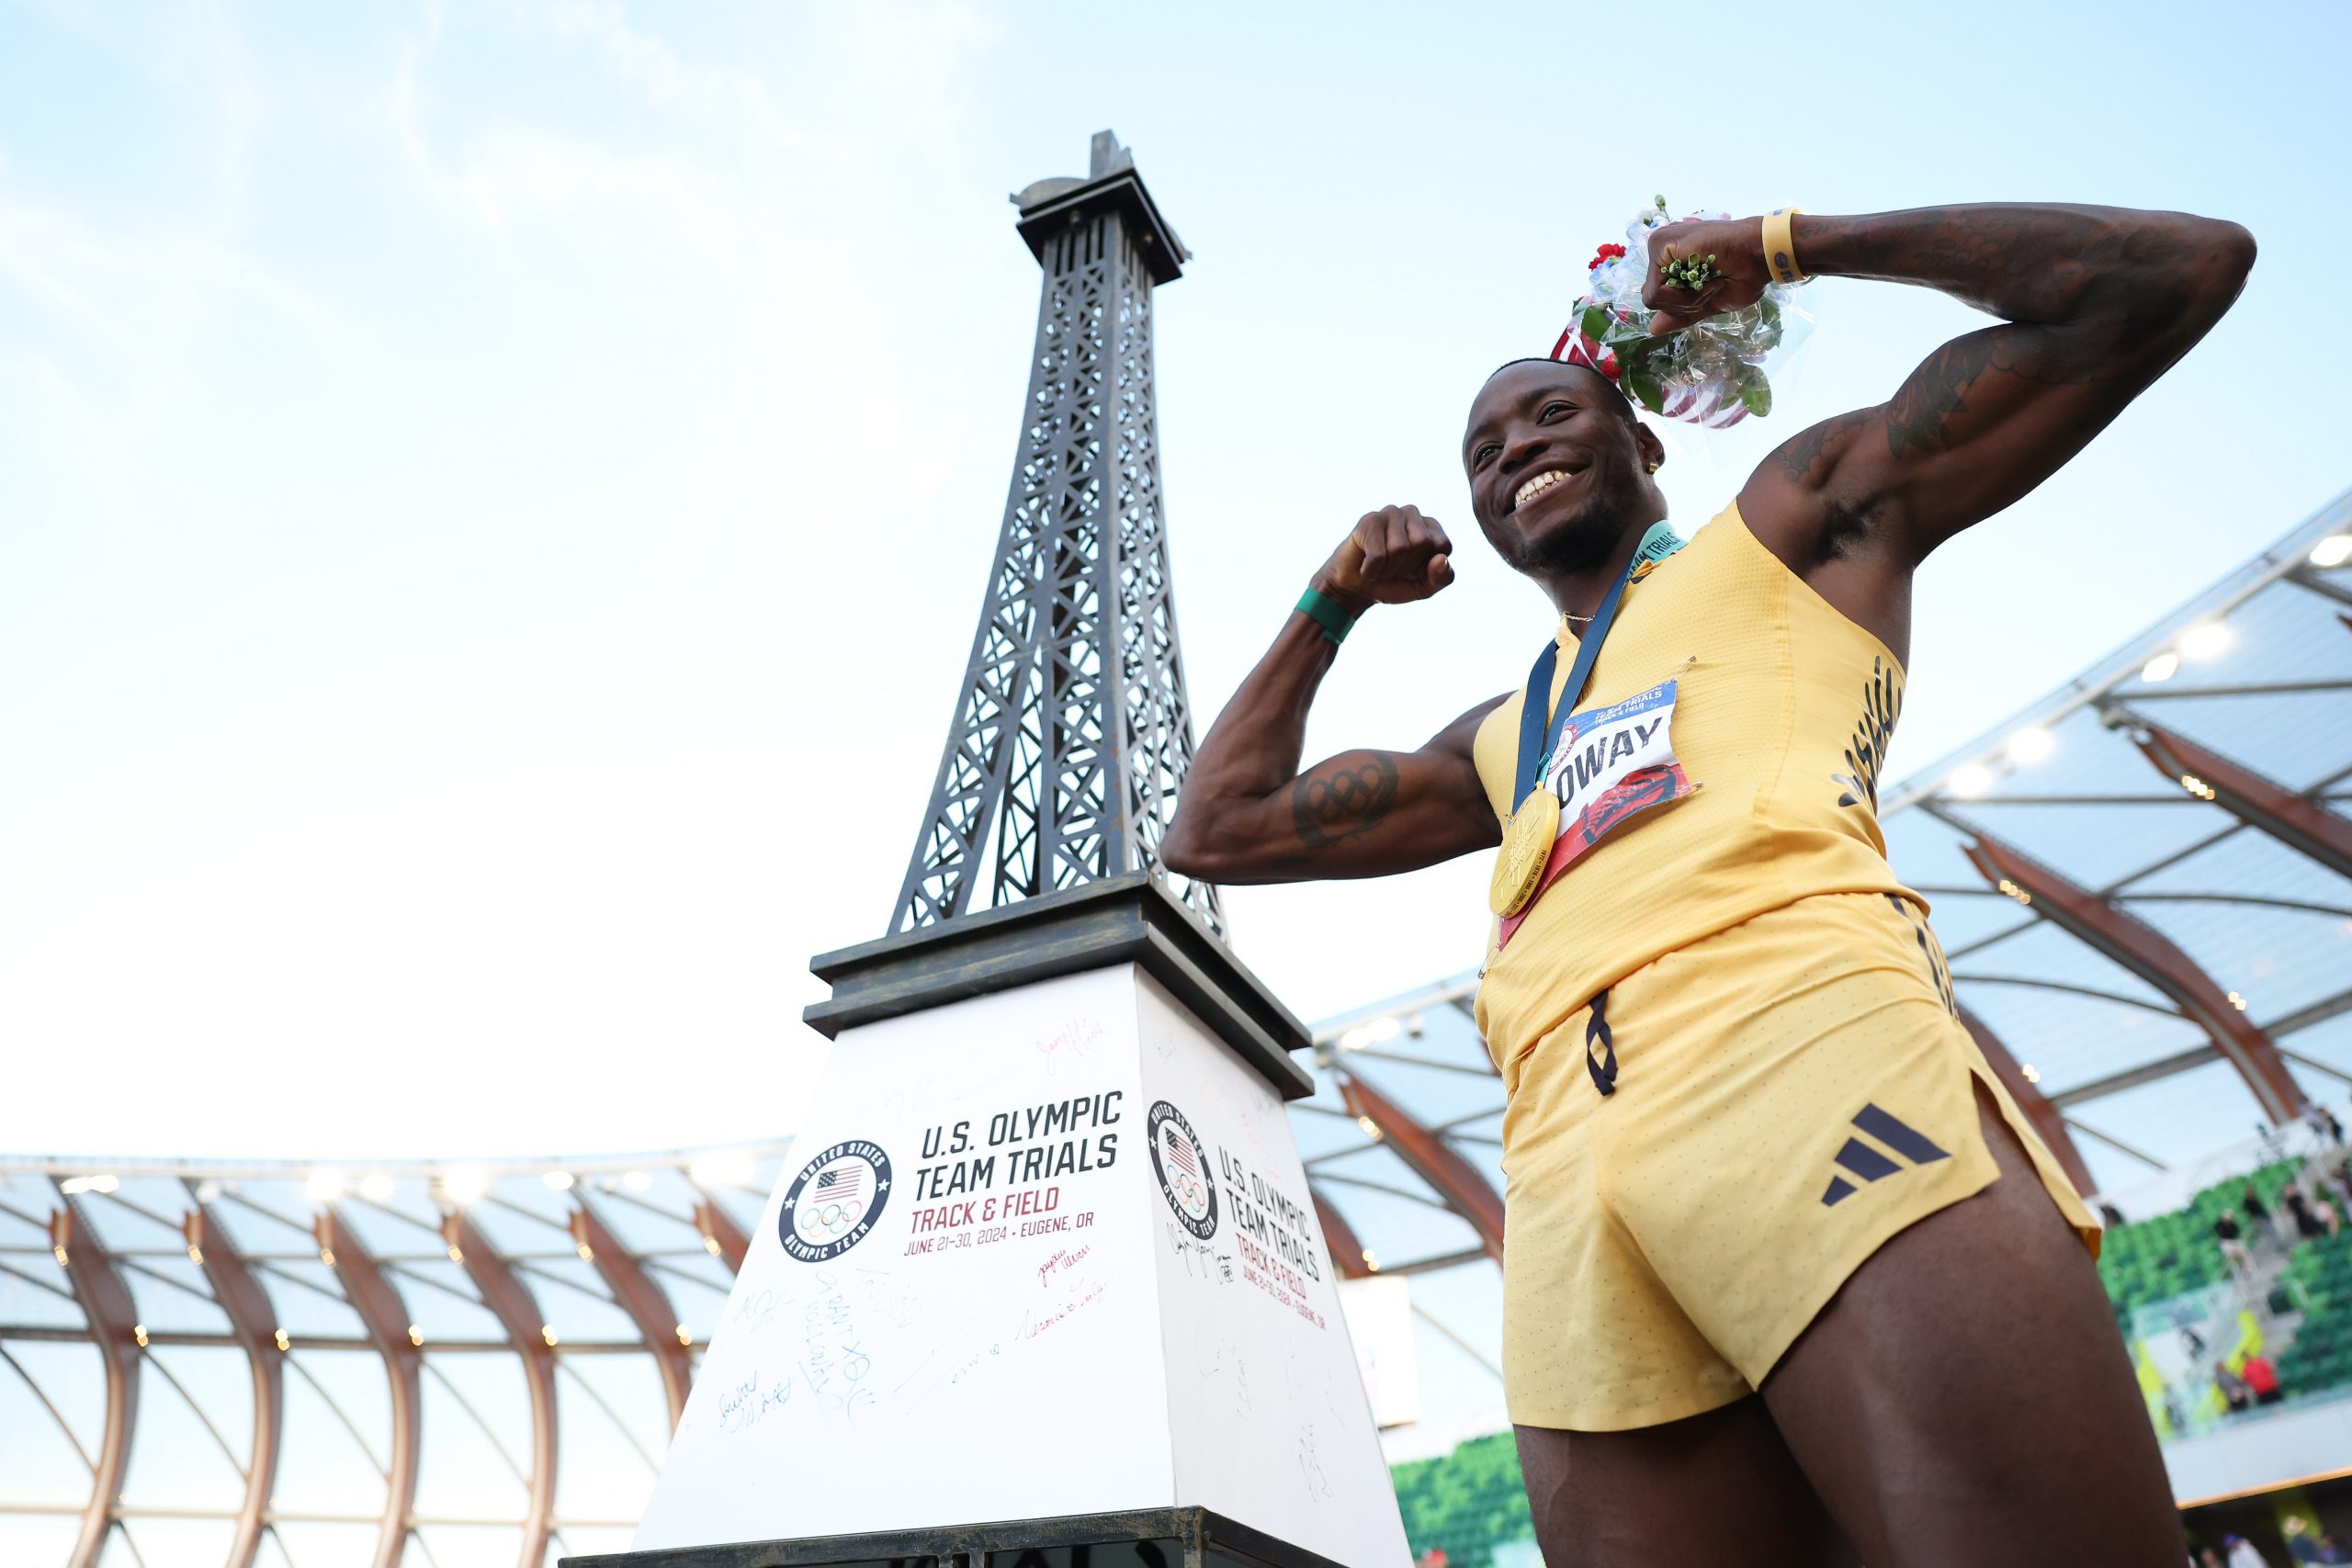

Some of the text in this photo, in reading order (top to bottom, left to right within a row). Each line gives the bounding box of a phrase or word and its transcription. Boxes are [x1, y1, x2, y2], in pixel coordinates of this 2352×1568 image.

[1646, 531, 1680, 555] TRIALS
[1539, 850, 1547, 862] 1972
[922, 1090, 1123, 1159] U.S. OLYMPIC
[1150, 1104, 1204, 1157] UNITED STATES
[799, 1143, 886, 1182] UNITED STATES
[916, 1134, 1118, 1201] TEAM TRIALS
[910, 1187, 1059, 1235] TRACK & FIELD
[1163, 1184, 1216, 1236] OLYMPIC TEAM
[1218, 1145, 1311, 1242] U.S. OLYMPIC
[784, 1222, 869, 1260] OLYMPIC TEAM
[904, 1212, 1094, 1257] JUNE 21-30, 2024 EUGENE, OR
[1226, 1188, 1270, 1247] TEAM
[1269, 1221, 1320, 1282] TRIALS
[1236, 1232, 1272, 1277] TRACK
[1280, 1263, 1306, 1300] FIELD
